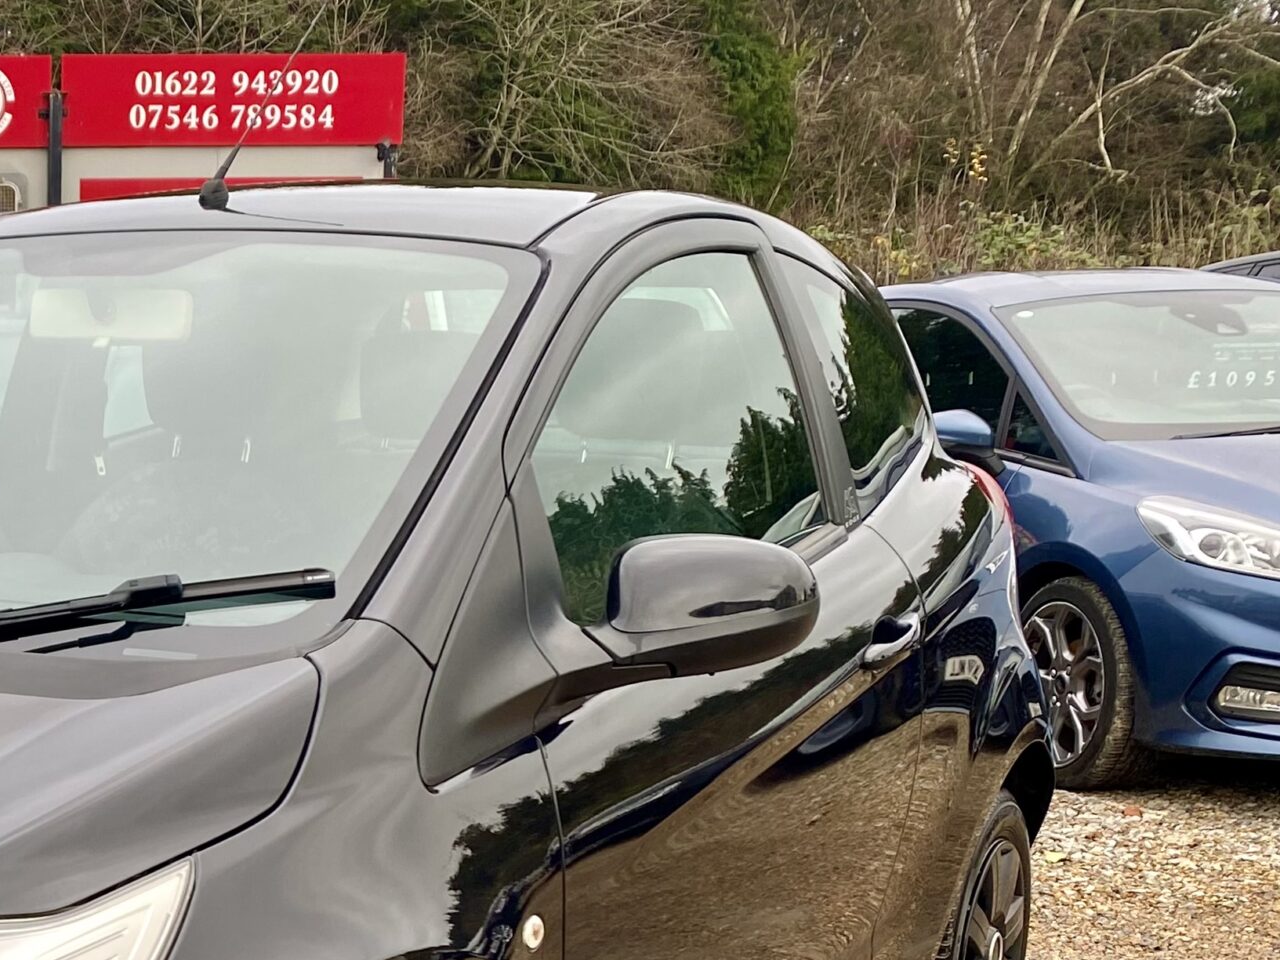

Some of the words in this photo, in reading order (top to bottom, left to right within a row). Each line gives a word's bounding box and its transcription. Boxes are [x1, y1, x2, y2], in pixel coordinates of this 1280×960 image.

[135, 70, 216, 96] 01622
[232, 70, 339, 96] 943920
[129, 104, 218, 129] 07546
[230, 104, 334, 129] 789584
